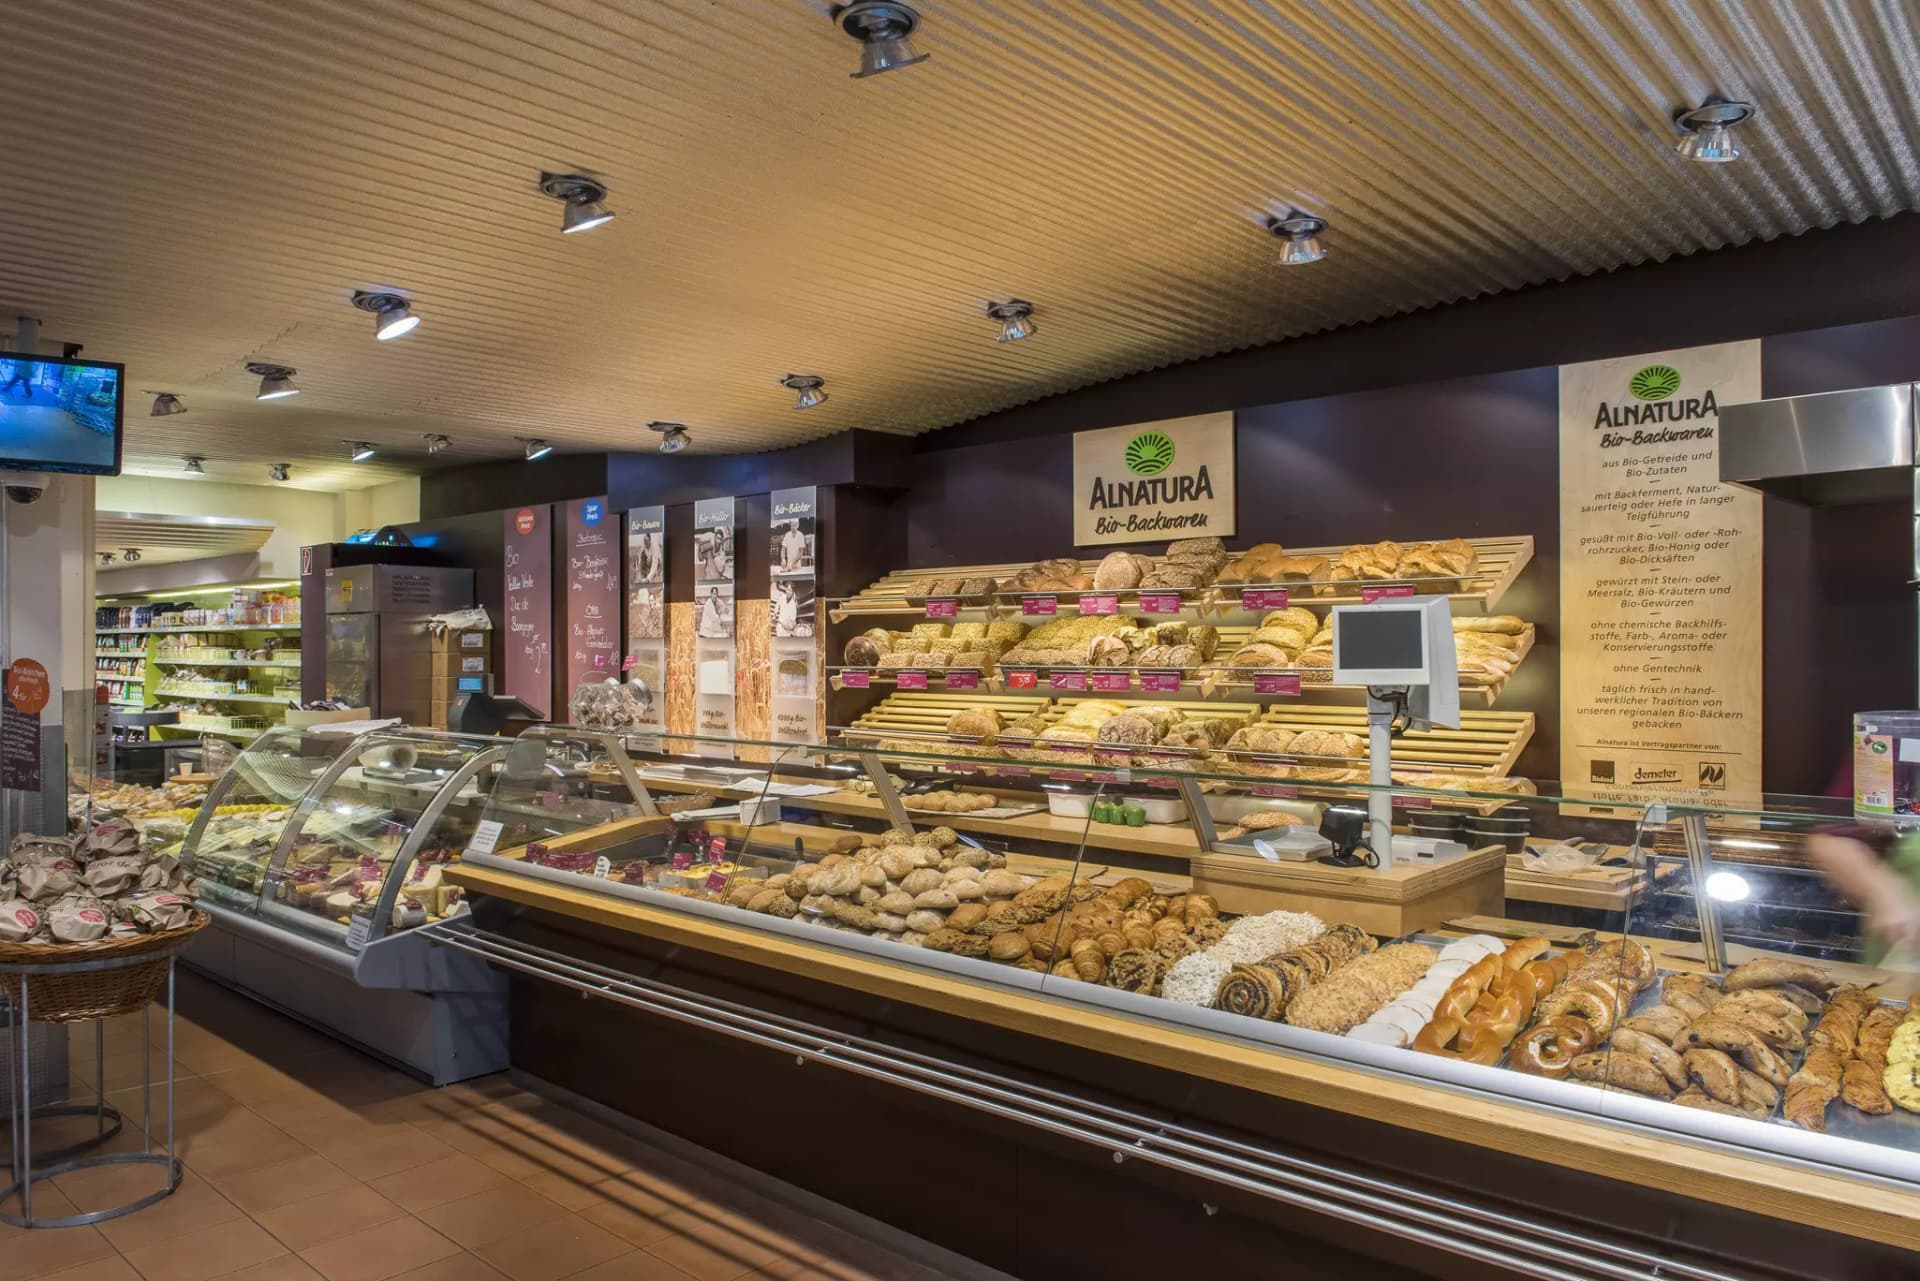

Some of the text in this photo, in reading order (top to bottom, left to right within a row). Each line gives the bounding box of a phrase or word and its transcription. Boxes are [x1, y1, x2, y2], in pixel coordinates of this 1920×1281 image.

[1594, 390, 1719, 429] ALNATURA
[1600, 427, 1713, 448] Bio-Backwaren
[1602, 451, 1712, 468] aus Bio-Getreide und
[1626, 465, 1687, 477] Bio-Zutaten
[1090, 465, 1213, 510] ALNATURA
[1595, 485, 1720, 500] mit Backferment, Natur-
[774, 502, 811, 515] Bio-Bäcker
[1581, 495, 1735, 513] sauerteig oder Hefe in langer
[1627, 510, 1690, 522] Teigführung
[1095, 511, 1207, 535] Bio-Backwaren
[1580, 528, 1742, 545] gesüßt mit Bio-Voll- oder -Roh-
[1588, 541, 1730, 555] rohrzucker, Bio-Honig oder
[1620, 554, 1694, 565] Bio-Dicksäften
[1596, 576, 1637, 588] gewürzt
[1662, 576, 1691, 584] Stein-
[1696, 574, 1720, 583] oder
[1588, 585, 1731, 598] Meersalz, Bio-Kräutern und
[1621, 599, 1693, 608] Bio-Gewürzen
[1591, 620, 1727, 629] ohne chemische Backhilfs-
[1590, 631, 1727, 641] stoffe, Farb-, Aroma- oder
[1603, 642, 1713, 653] Konservierungsstoffe
[1613, 664, 1702, 673] ohne Gentechnik
[1602, 685, 1715, 695] täglich frisch in hand-
[1595, 696, 1722, 707] werklicher Tradition von
[1577, 708, 1743, 719] unseren regionalen Bio-Bäckern
[1632, 720, 1682, 729] gebacken
[1642, 740, 1701, 750] Vertragspartner
[1634, 768, 1677, 779] demeter
